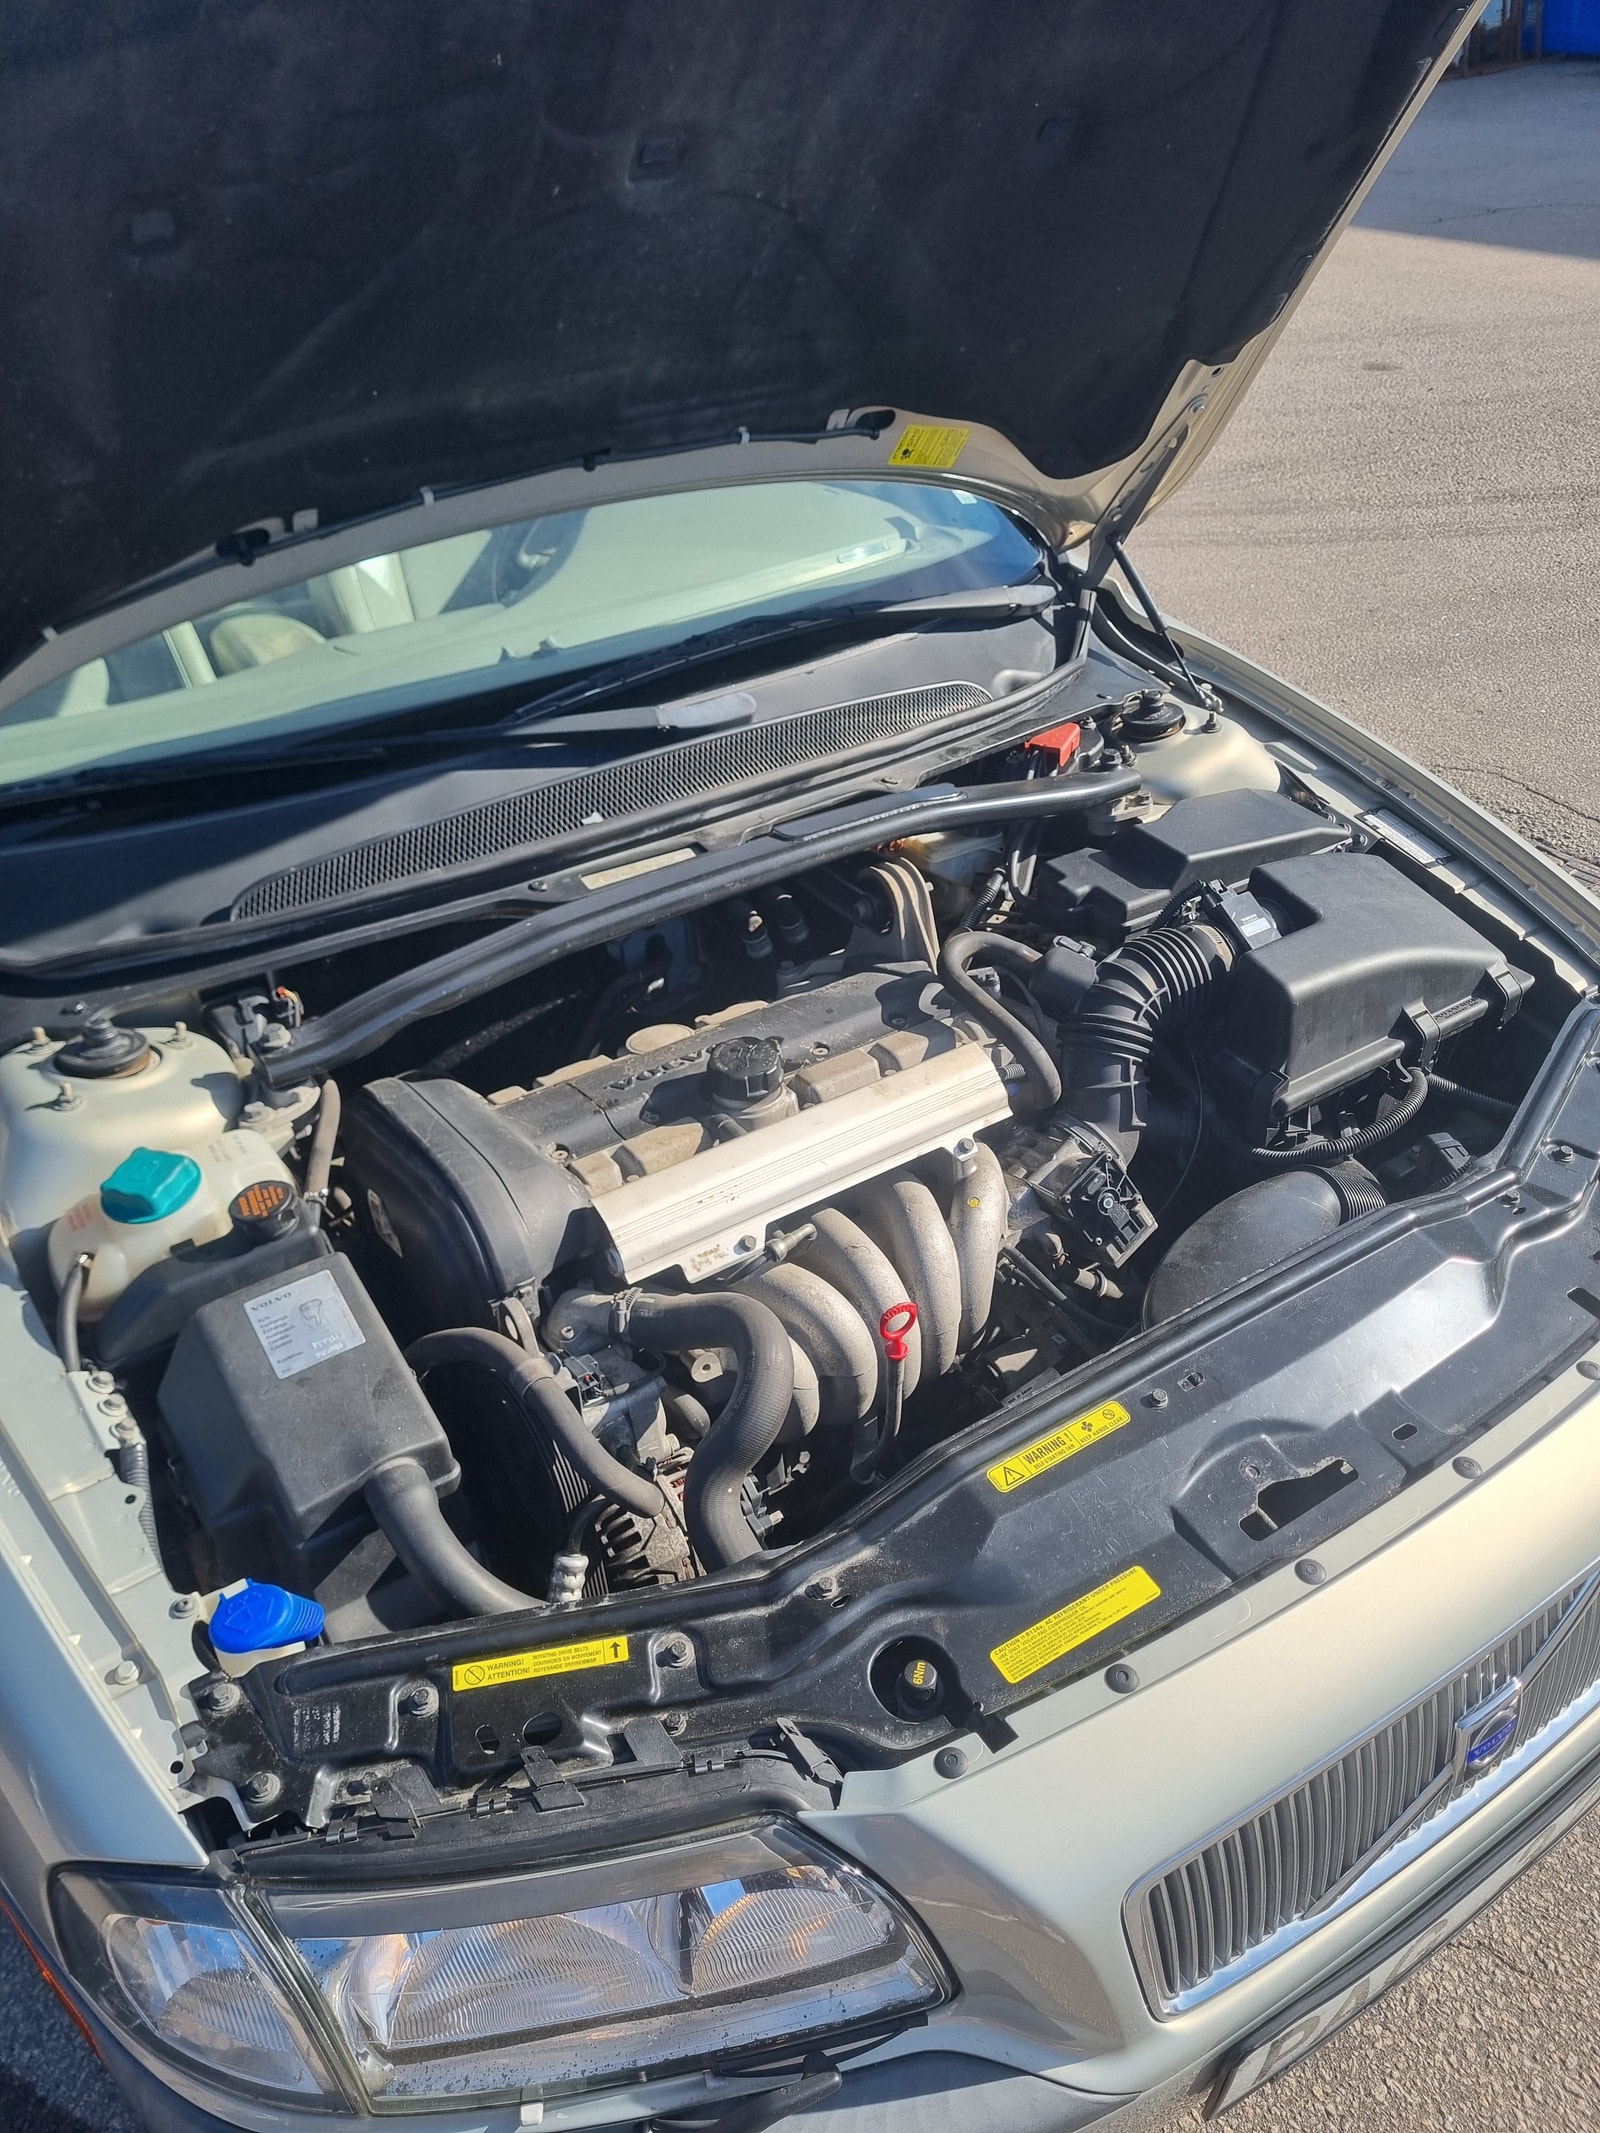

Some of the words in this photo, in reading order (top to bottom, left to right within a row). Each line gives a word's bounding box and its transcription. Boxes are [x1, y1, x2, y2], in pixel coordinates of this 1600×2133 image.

[251, 1292, 291, 1311] VOLVO
[1079, 1433, 1092, 1443] KEEP
[1091, 1424, 1109, 1436] HANDS
[1108, 1416, 1123, 1427] CLEAR
[1022, 1436, 1066, 1465] WARNING
[1063, 1432, 1072, 1442] !
[1033, 1448, 1067, 1470] SELF-STARTING
[1065, 1443, 1076, 1451] FAN
[994, 1637, 1020, 1656] CAUTION
[1045, 1618, 1053, 1626] AC
[1052, 1595, 1090, 1620] REFRIGERANT
[1090, 1584, 1110, 1598] UNDER
[1109, 1568, 1137, 1587] PRESSURE
[997, 1651, 1008, 1660] USE
[1007, 1643, 1021, 1654] ONLY
[1020, 1634, 1037, 1646] VOLVO
[1036, 1628, 1048, 1637] PAG
[1047, 1609, 1079, 1631] COMPRESSOR
[532, 1651, 557, 1660] ROTATING
[558, 1648, 572, 1656] DRIVE
[573, 1645, 589, 1653] BELTS
[571, 1649, 602, 1660] MOUVEMENT
[486, 1658, 524, 1671] WARNING!
[487, 1666, 530, 1681] ATTENTION!
[533, 1663, 563, 1673] ROTERANDE
[912, 1661, 926, 1685] 6Nm
